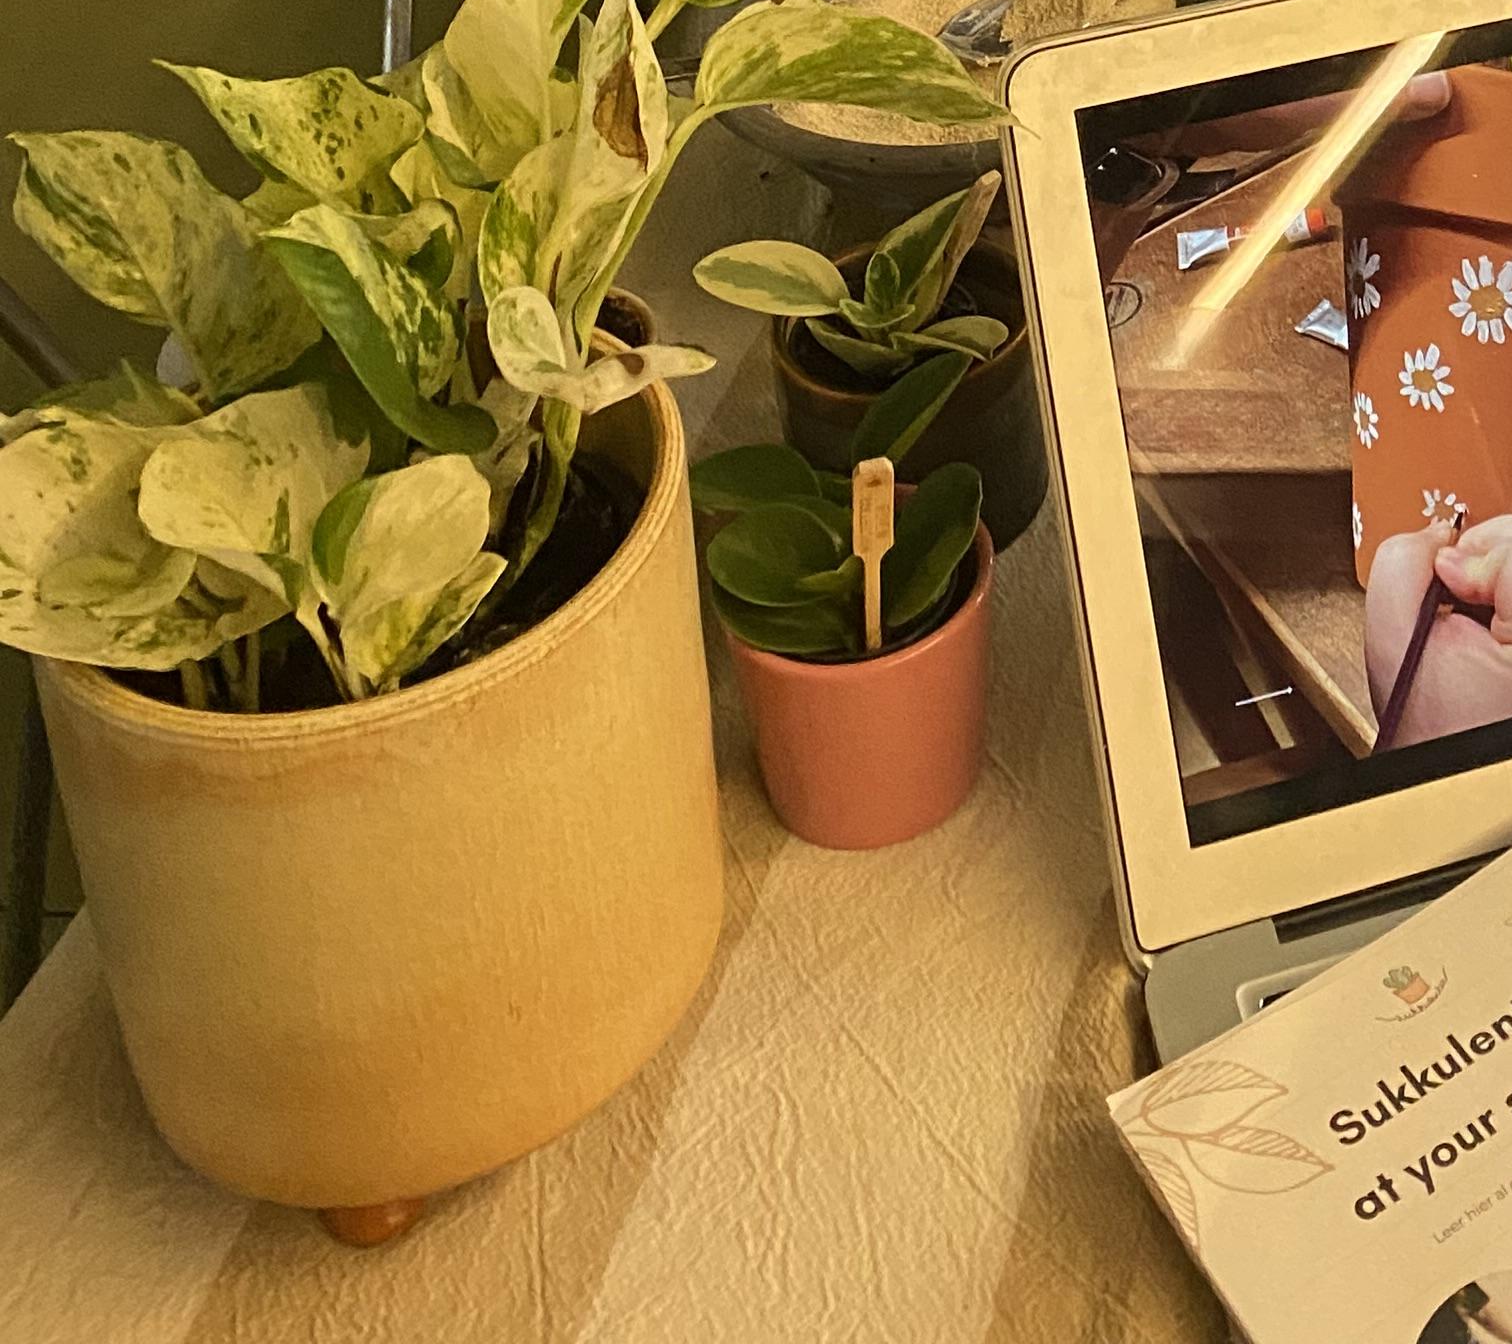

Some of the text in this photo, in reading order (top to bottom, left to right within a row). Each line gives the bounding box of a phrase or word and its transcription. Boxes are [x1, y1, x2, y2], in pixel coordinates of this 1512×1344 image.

[1354, 1173, 1402, 1221] at
[1403, 1109, 1498, 1196] your
[1433, 1215, 1466, 1245] Leer
[1464, 1195, 1493, 1223] hier
[1495, 1183, 1508, 1201] al
